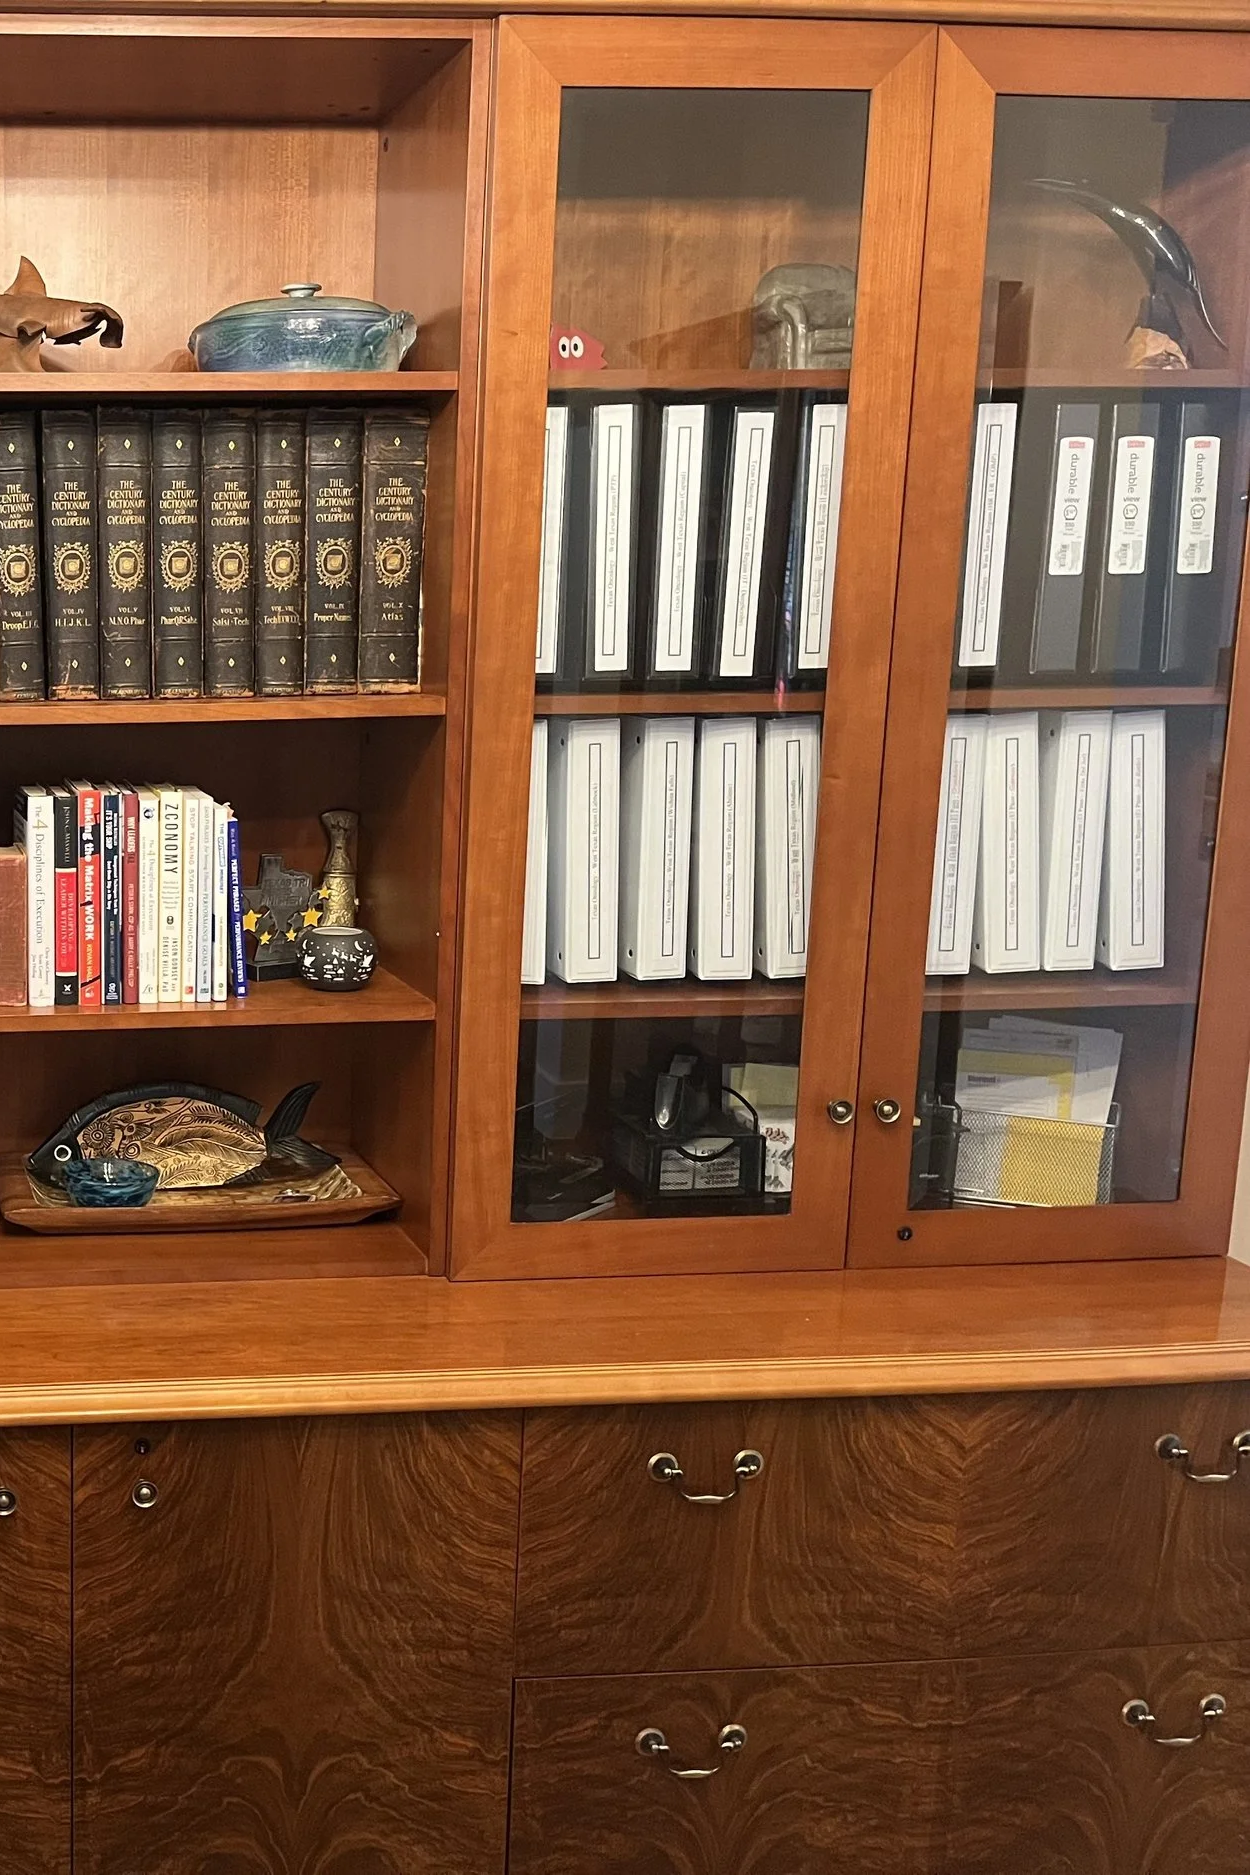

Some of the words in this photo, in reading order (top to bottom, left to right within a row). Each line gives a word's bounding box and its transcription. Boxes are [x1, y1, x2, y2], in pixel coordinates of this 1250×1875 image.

[1068, 454, 1080, 494] durable
[1128, 453, 1139, 493] durable
[1195, 453, 1205, 493] durable
[64, 482, 78, 490] THE
[120, 480, 134, 489] THE
[171, 480, 186, 489] THE
[224, 482, 239, 491] THE
[276, 480, 291, 489] THE
[329, 479, 344, 487] THE
[388, 478, 403, 486] THE
[6, 484, 21, 494] THE
[110, 490, 143, 498] CENTURY
[319, 488, 351, 497] CENTURY
[378, 487, 412, 496] CENTURY
[54, 491, 87, 500] CENTURY
[162, 490, 195, 499] CENTURY
[214, 492, 247, 500] CENTURY
[266, 490, 299, 499] CENTURY
[52, 501, 90, 510] DICTIONARY
[108, 500, 146, 509] DICTIONARY
[160, 500, 198, 509] DICTIONARY
[212, 500, 251, 510] DICTIONARY
[264, 499, 302, 509] DICTIONARY
[316, 498, 355, 507] DICTIONARY
[376, 496, 414, 506] DICTIONARY
[52, 517, 90, 526] CYCLOPEDIA
[107, 515, 145, 525] CYCLOPEDIA
[159, 515, 198, 525] CYCLOPEDIA
[211, 517, 250, 527] CYCLOPEDIA
[263, 515, 301, 525] CYCLOPEDIA
[315, 513, 354, 523] CYCLOPEDIA
[375, 512, 414, 522] CYCLOPEDIA
[381, 613, 404, 621] Atlas
[32, 819, 49, 829] 4
[82, 798, 94, 840] Making
[127, 816, 135, 829] WHY
[127, 830, 135, 852] LEADERS
[164, 804, 178, 874] ZCONOMY
[33, 833, 45, 882] Disciplines
[84, 843, 94, 863] the
[84, 865, 94, 902] Matrix
[36, 886, 45, 896] of
[36, 899, 45, 944] Execution
[85, 904, 94, 940] WORK
